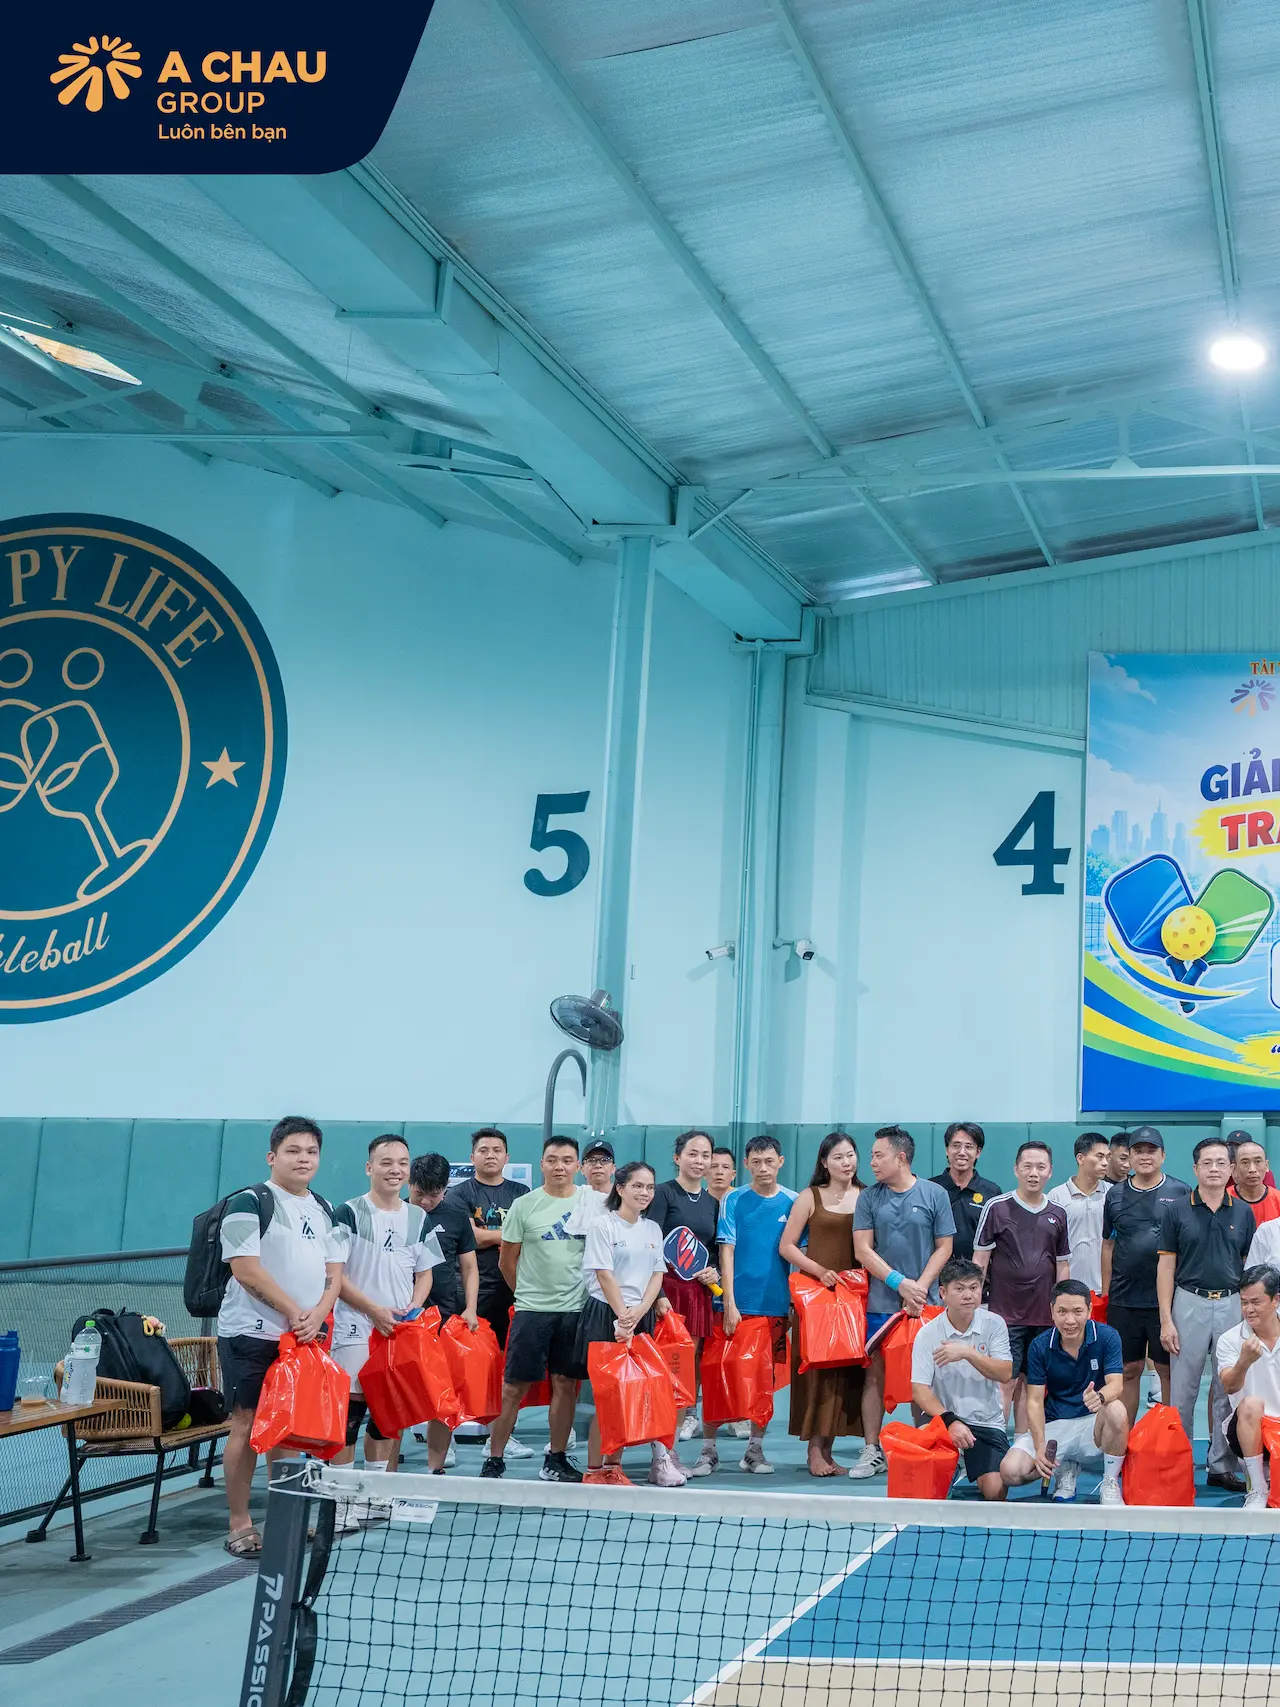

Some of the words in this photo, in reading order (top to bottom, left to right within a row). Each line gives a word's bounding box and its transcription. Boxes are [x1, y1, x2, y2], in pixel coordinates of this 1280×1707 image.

[94, 552, 225, 669] LIFE
[1250, 658, 1274, 675] TÀI
[523, 790, 590, 897] 5
[992, 791, 1071, 895] 4
[255, 1319, 264, 1330] 3
[350, 1324, 357, 1334] 3
